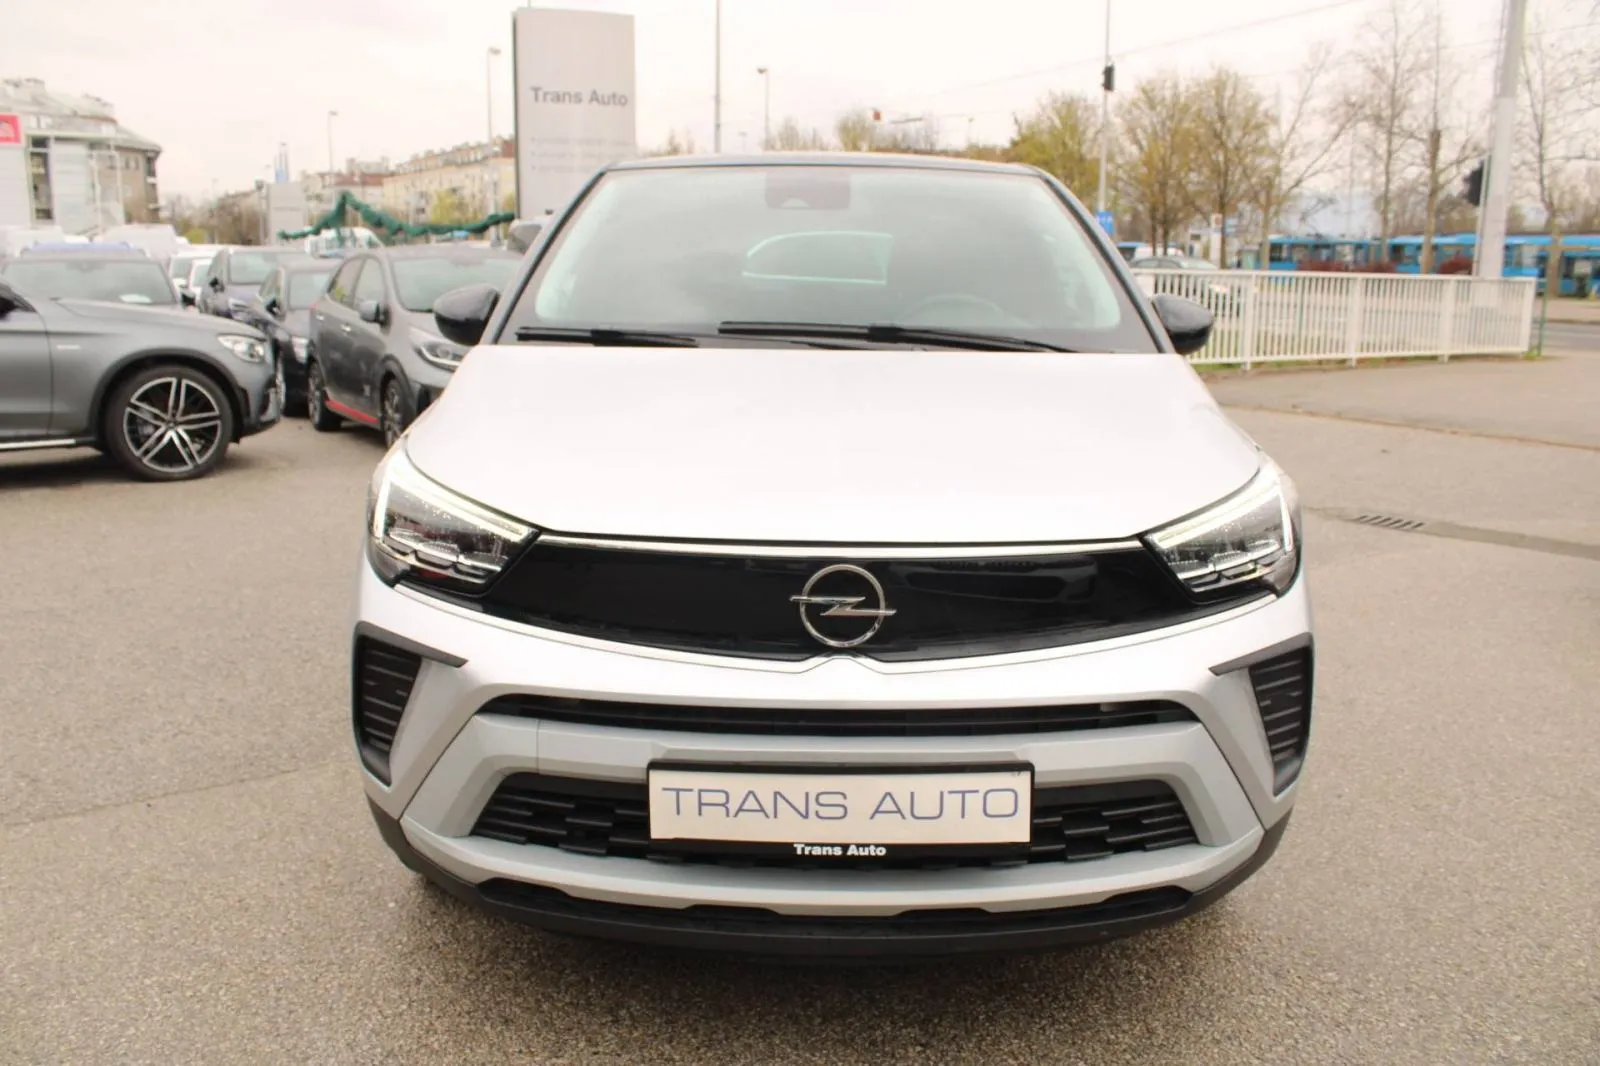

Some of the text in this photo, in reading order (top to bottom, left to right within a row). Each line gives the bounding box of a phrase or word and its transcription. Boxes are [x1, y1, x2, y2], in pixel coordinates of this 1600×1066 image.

[530, 86, 629, 106] Trans Auto
[662, 787, 1019, 821] TRANS AUTO
[793, 843, 887, 857] Trans Auto
